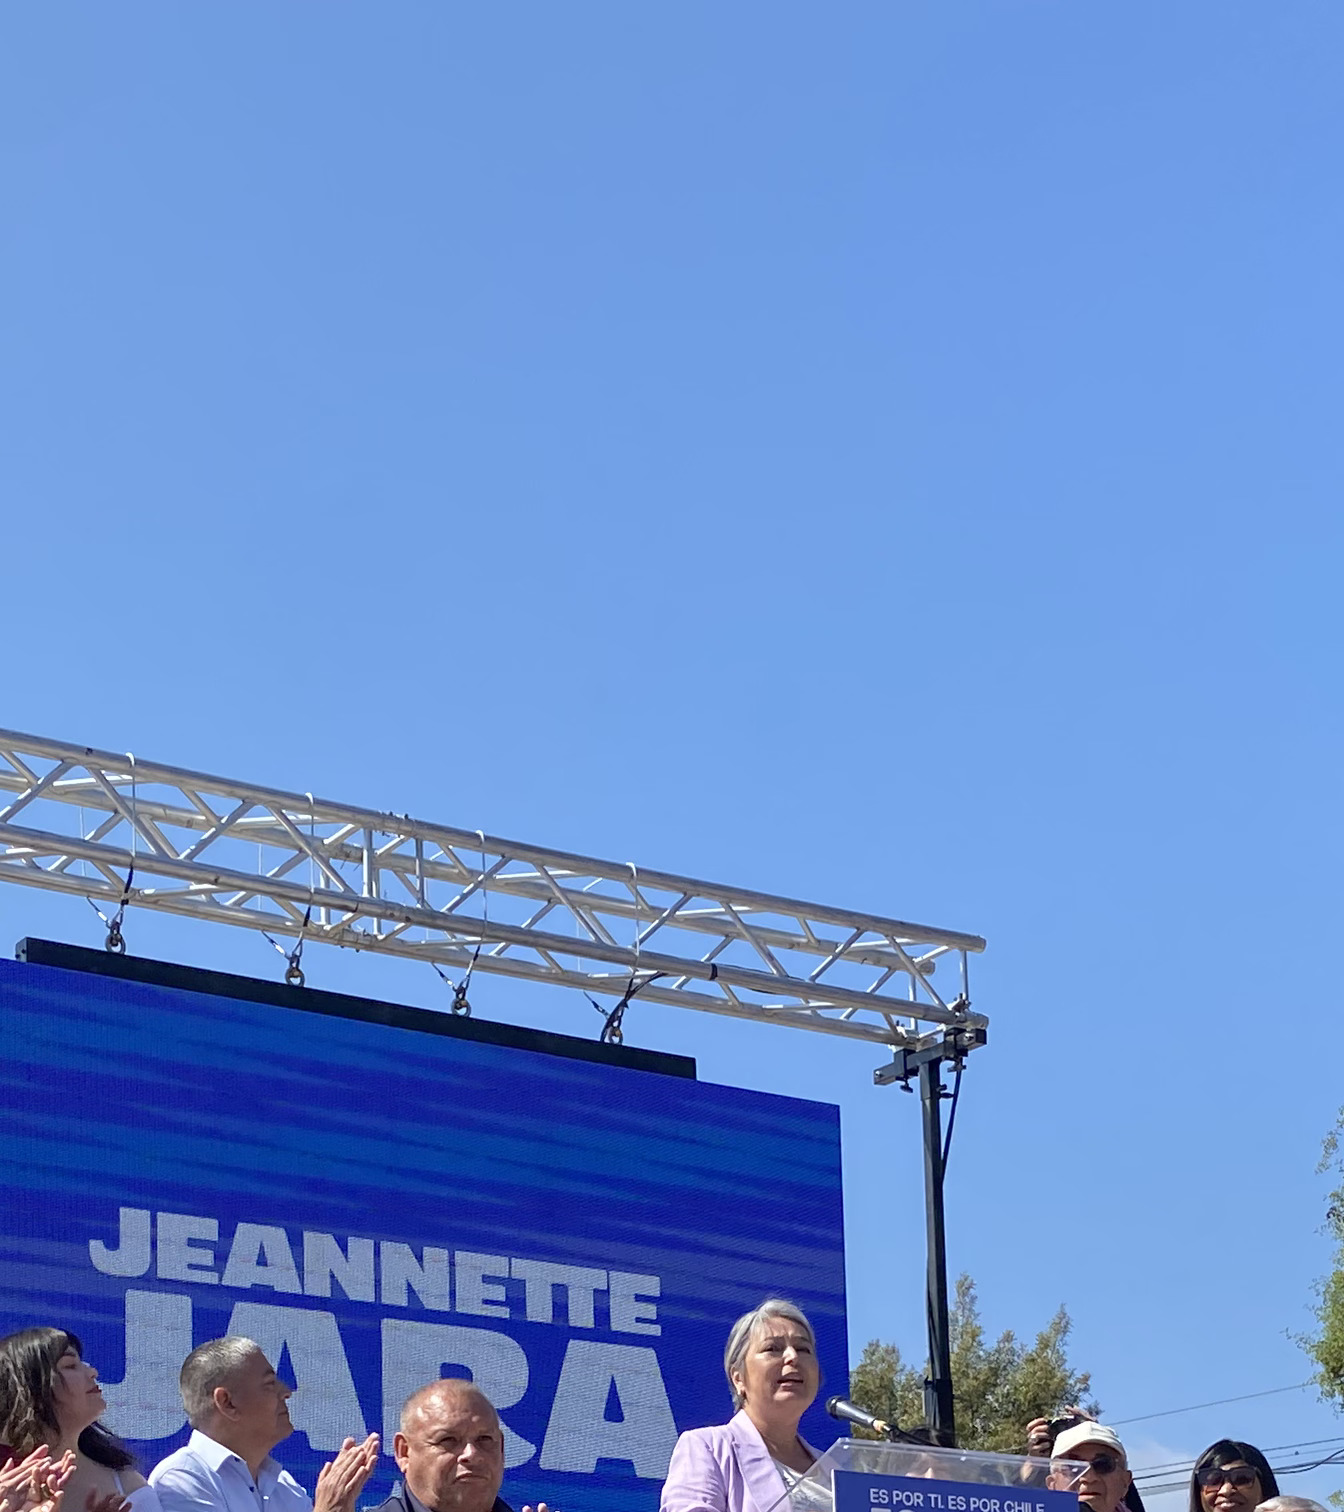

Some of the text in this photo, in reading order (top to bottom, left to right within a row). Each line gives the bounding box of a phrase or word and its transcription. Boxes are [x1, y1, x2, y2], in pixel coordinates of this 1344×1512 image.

[89, 1207, 661, 1336] JEANNETTE
[97, 1289, 682, 1479] JARA
[869, 1488, 889, 1504] ES
[893, 1490, 924, 1507] POR
[948, 1496, 967, 1511] ES
